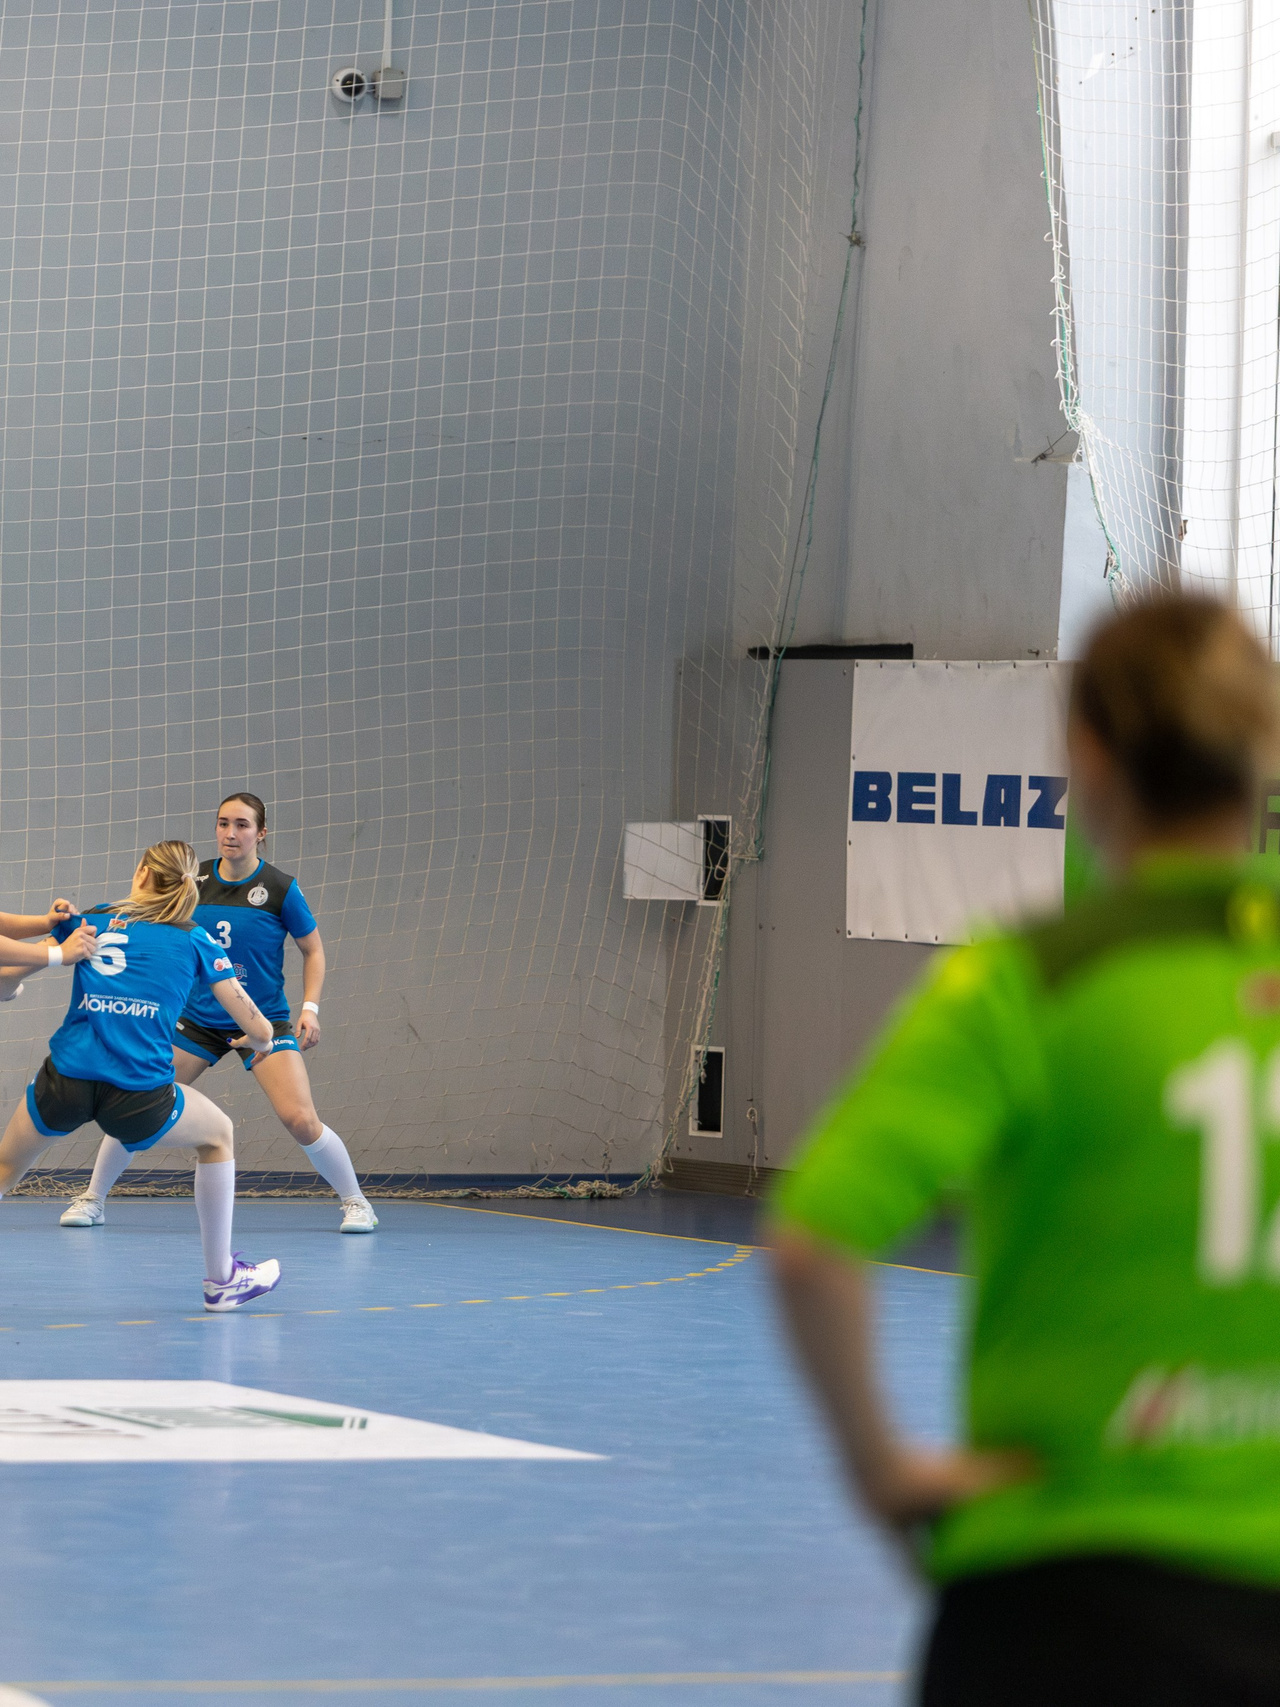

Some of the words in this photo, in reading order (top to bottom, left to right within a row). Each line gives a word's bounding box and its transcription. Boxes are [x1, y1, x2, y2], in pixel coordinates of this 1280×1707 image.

[852, 771, 1068, 829] BELAZ
[90, 932, 129, 976] 6
[216, 920, 232, 949] 3
